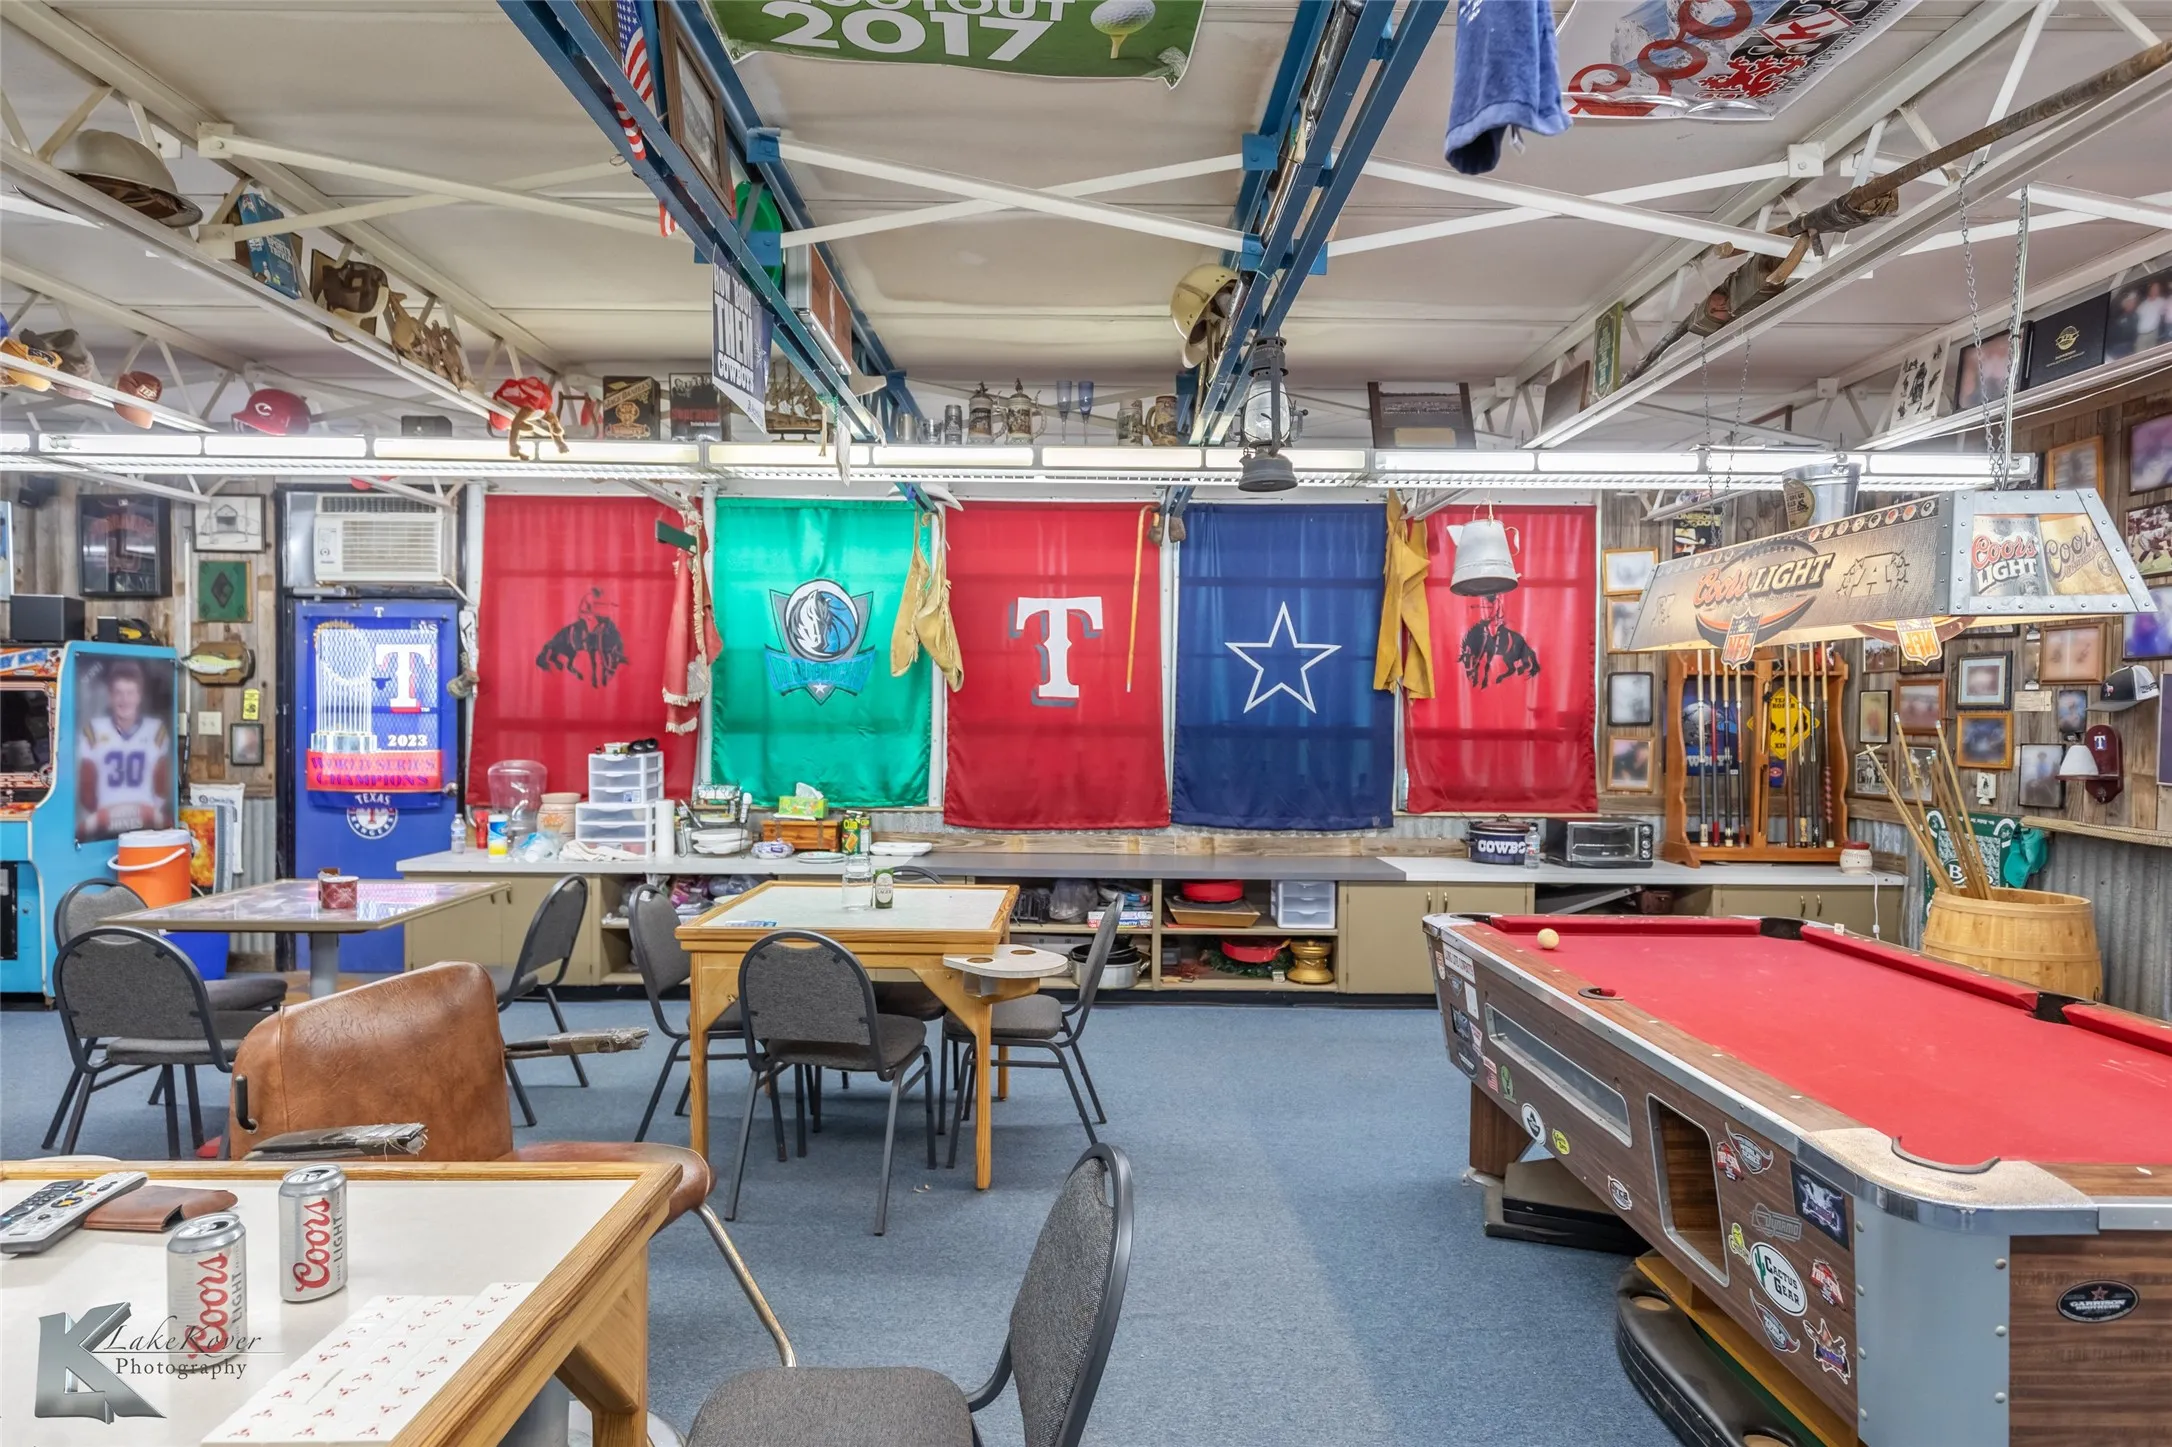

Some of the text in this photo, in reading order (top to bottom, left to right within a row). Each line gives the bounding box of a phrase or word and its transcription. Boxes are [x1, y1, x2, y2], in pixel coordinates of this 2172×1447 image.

[762, 1, 1054, 62] 2017
[1850, 0, 1900, 36] KILPATRIC
[713, 262, 731, 299] HOW
[714, 293, 753, 372] THEM
[717, 351, 754, 394] COWBOYS
[1972, 534, 2038, 570] Coors
[2045, 526, 2100, 582] Coors
[1693, 552, 1836, 608] Coors LIGHT
[1977, 558, 2038, 594] LIGHT
[1008, 596, 1104, 706] T
[1726, 633, 1753, 660] NFL
[376, 644, 433, 713] T
[387, 734, 428, 748] 2023
[2094, 735, 2106, 750] T
[104, 751, 146, 787] 30
[316, 774, 429, 787] CHAMPIONS
[354, 793, 391, 806] TEXAS
[1478, 839, 1527, 855] COWBO
[292, 1197, 331, 1293] Coors
[333, 1215, 343, 1263] LIGHT
[1764, 1255, 1798, 1290] CACTUS
[185, 1251, 229, 1360] Coors
[231, 1271, 243, 1325] LIGHT
[1773, 1276, 1800, 1306] GEAR
[2069, 1299, 2127, 1308] GARRISON
